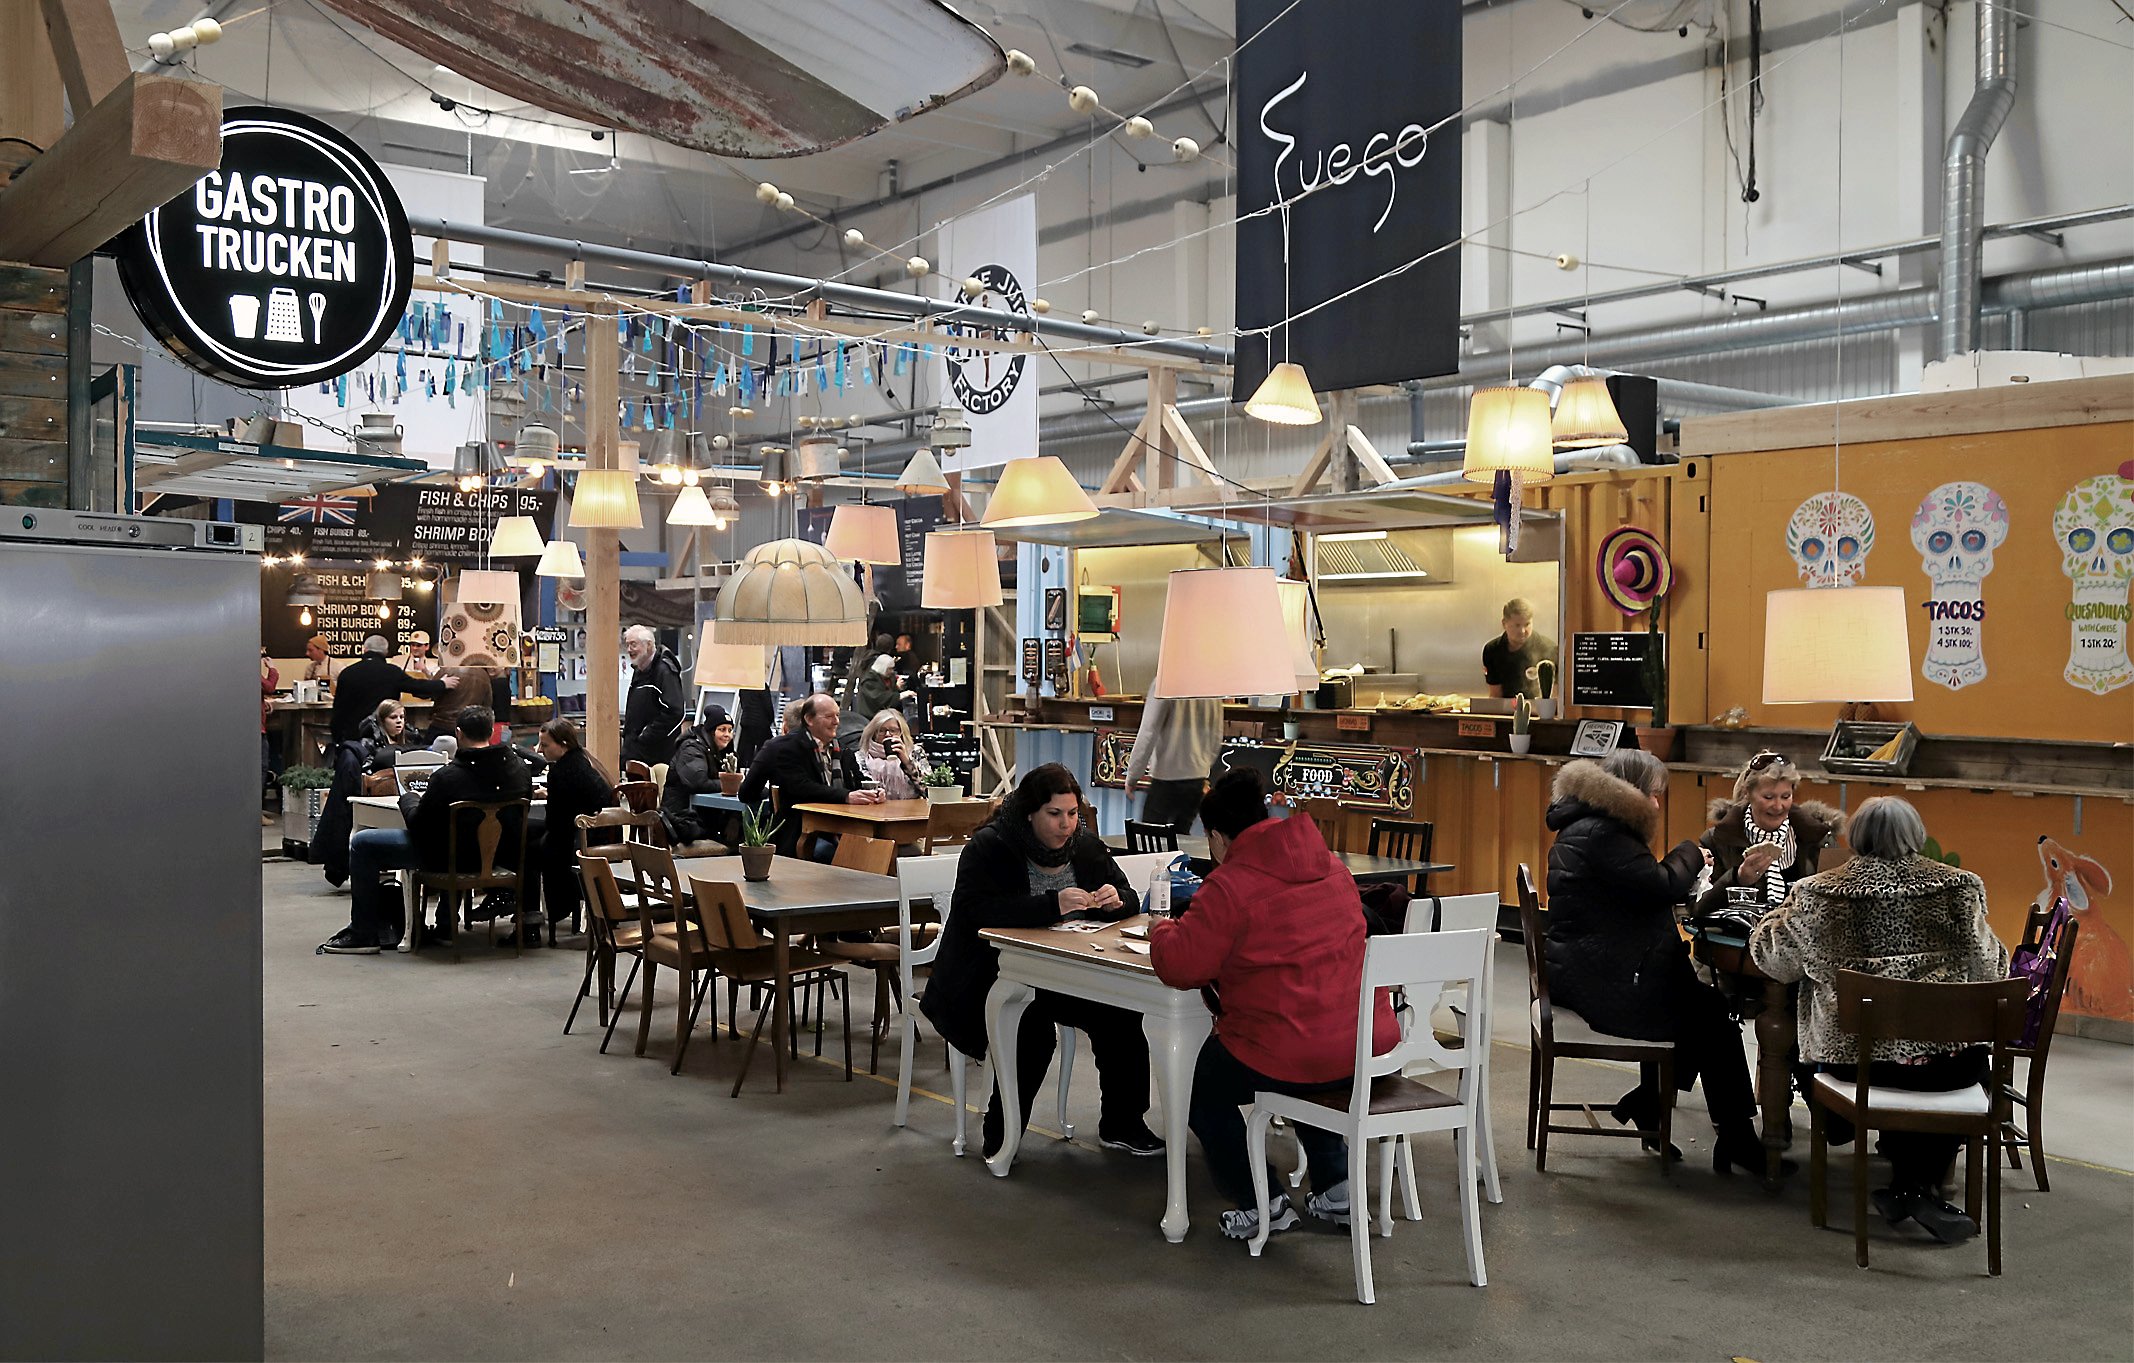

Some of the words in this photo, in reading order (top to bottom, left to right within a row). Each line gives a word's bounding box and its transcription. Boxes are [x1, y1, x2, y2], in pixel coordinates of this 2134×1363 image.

[1260, 70, 1428, 264] Fuego
[196, 170, 355, 235] GASTRO
[196, 223, 356, 283] TRUCKEN
[954, 360, 1020, 412] FACTORY
[419, 490, 451, 506] FISH
[453, 492, 465, 507] &
[468, 493, 509, 509] CHIPS
[313, 527, 329, 536] FISH
[329, 528, 354, 537] BURGER
[413, 525, 465, 541] SHRIMP
[317, 575, 339, 586] FISH
[341, 576, 351, 587] &
[317, 604, 358, 616] SHRIMP
[360, 605, 380, 616] BOX
[1922, 600, 1985, 621] TACOS
[2065, 602, 2132, 623] QUESADILLAS
[317, 618, 340, 628] FISH
[340, 618, 382, 629] BURGER
[341, 631, 366, 642] ONLY
[1945, 626, 1960, 636] STK
[327, 644, 355, 655] RISPY
[1937, 638, 1943, 648] 4
[1945, 639, 1958, 648] STK
[2080, 639, 2086, 648] 1
[2087, 639, 2102, 648] STK
[1302, 768, 1333, 783] FOOD
